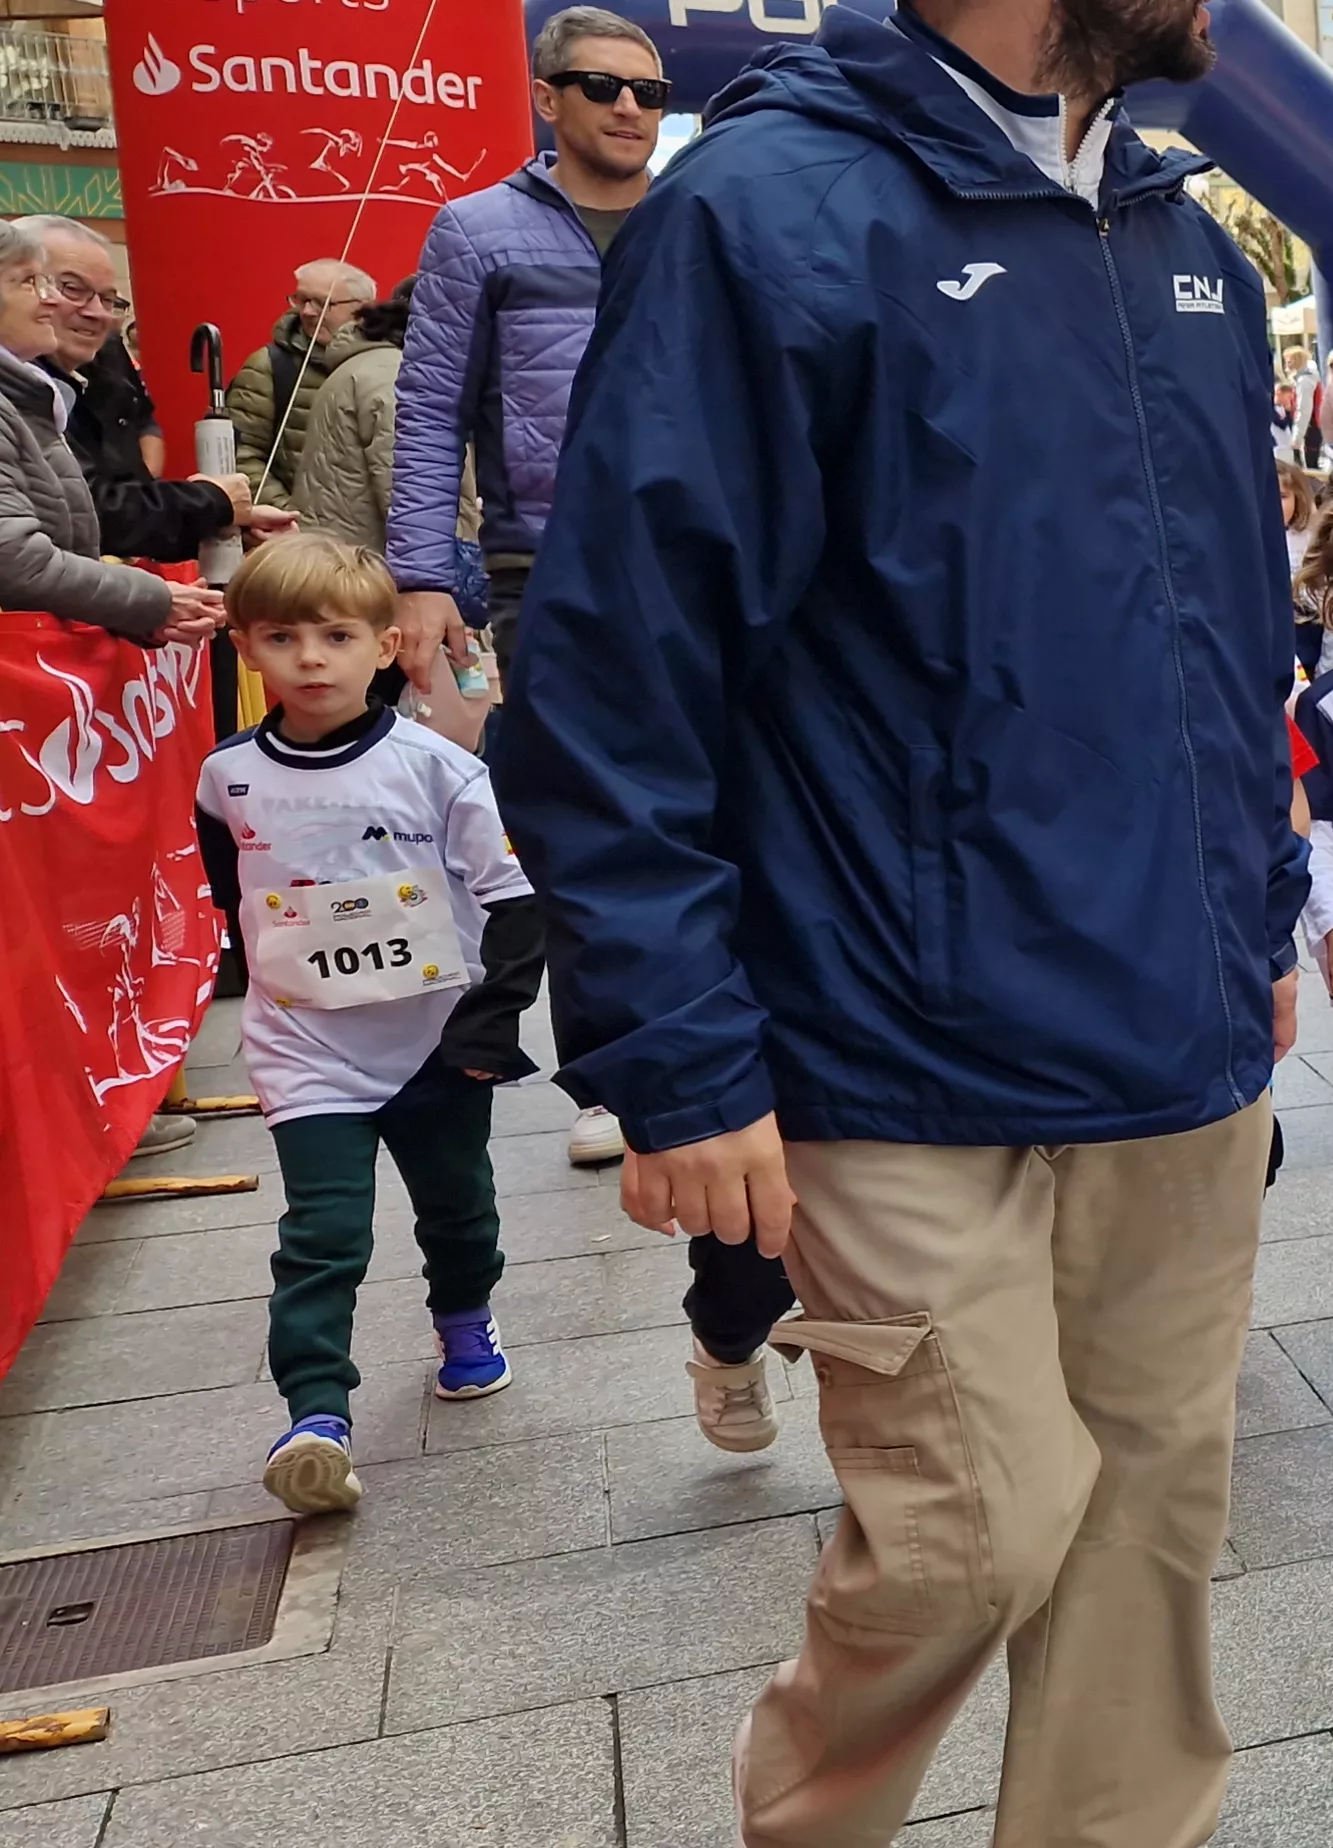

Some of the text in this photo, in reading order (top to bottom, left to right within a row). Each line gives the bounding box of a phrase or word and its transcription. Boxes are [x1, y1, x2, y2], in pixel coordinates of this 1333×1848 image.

[188, 44, 482, 109] Santander
[1173, 274, 1223, 302] CNJ
[393, 831, 433, 844] mupo
[308, 938, 412, 979] 1013
